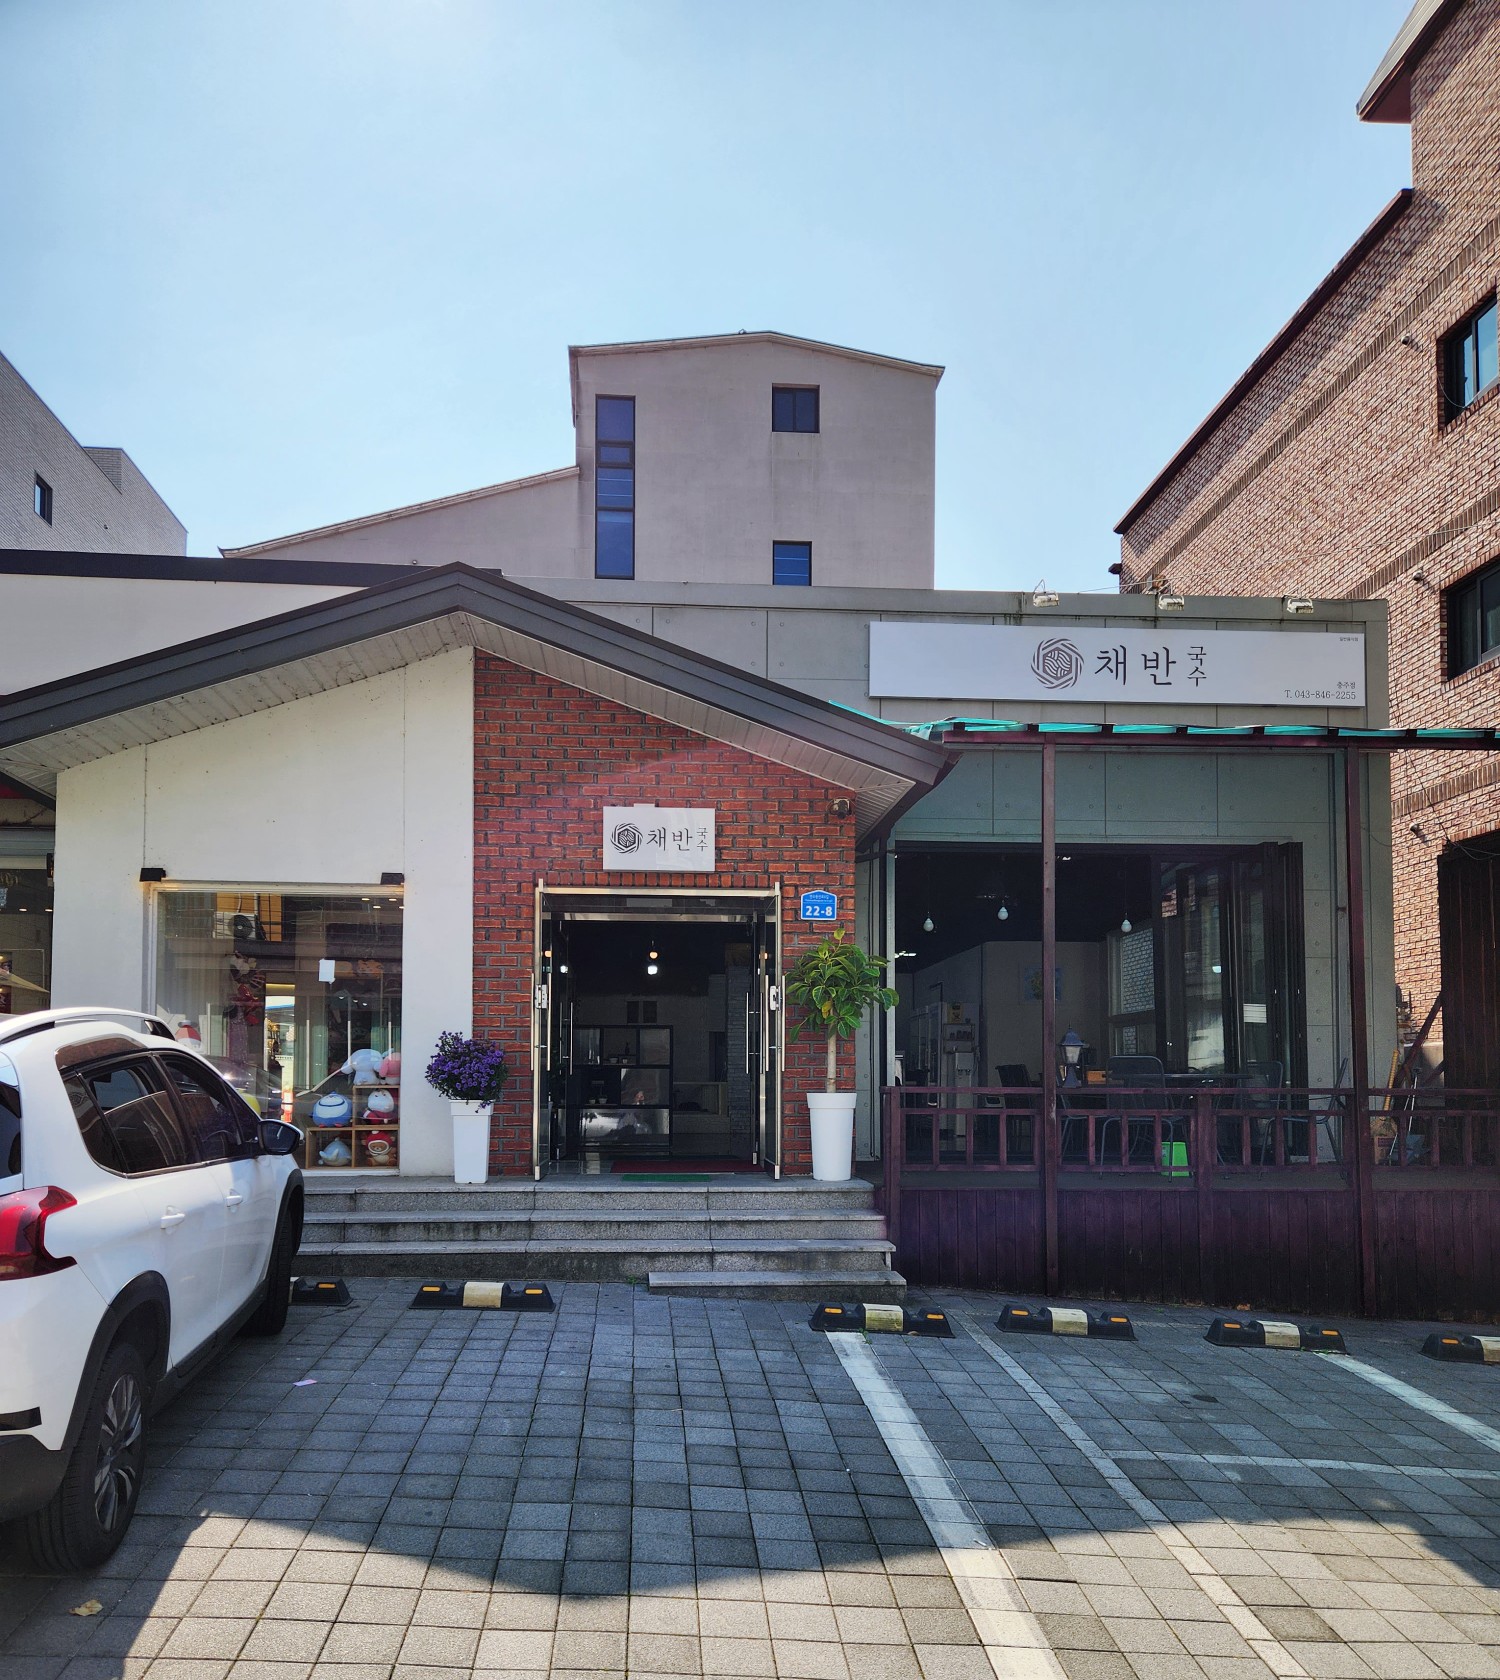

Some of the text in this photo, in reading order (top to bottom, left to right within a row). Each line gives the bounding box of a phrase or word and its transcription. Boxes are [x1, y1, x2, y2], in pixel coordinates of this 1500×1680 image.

[1094, 644, 1207, 687] 채반 국수
[1336, 681, 1356, 690] 충주점
[1294, 689, 1357, 700] 043-846-2255
[646, 826, 708, 852] 채반 국수
[805, 905, 833, 917] 22-8
